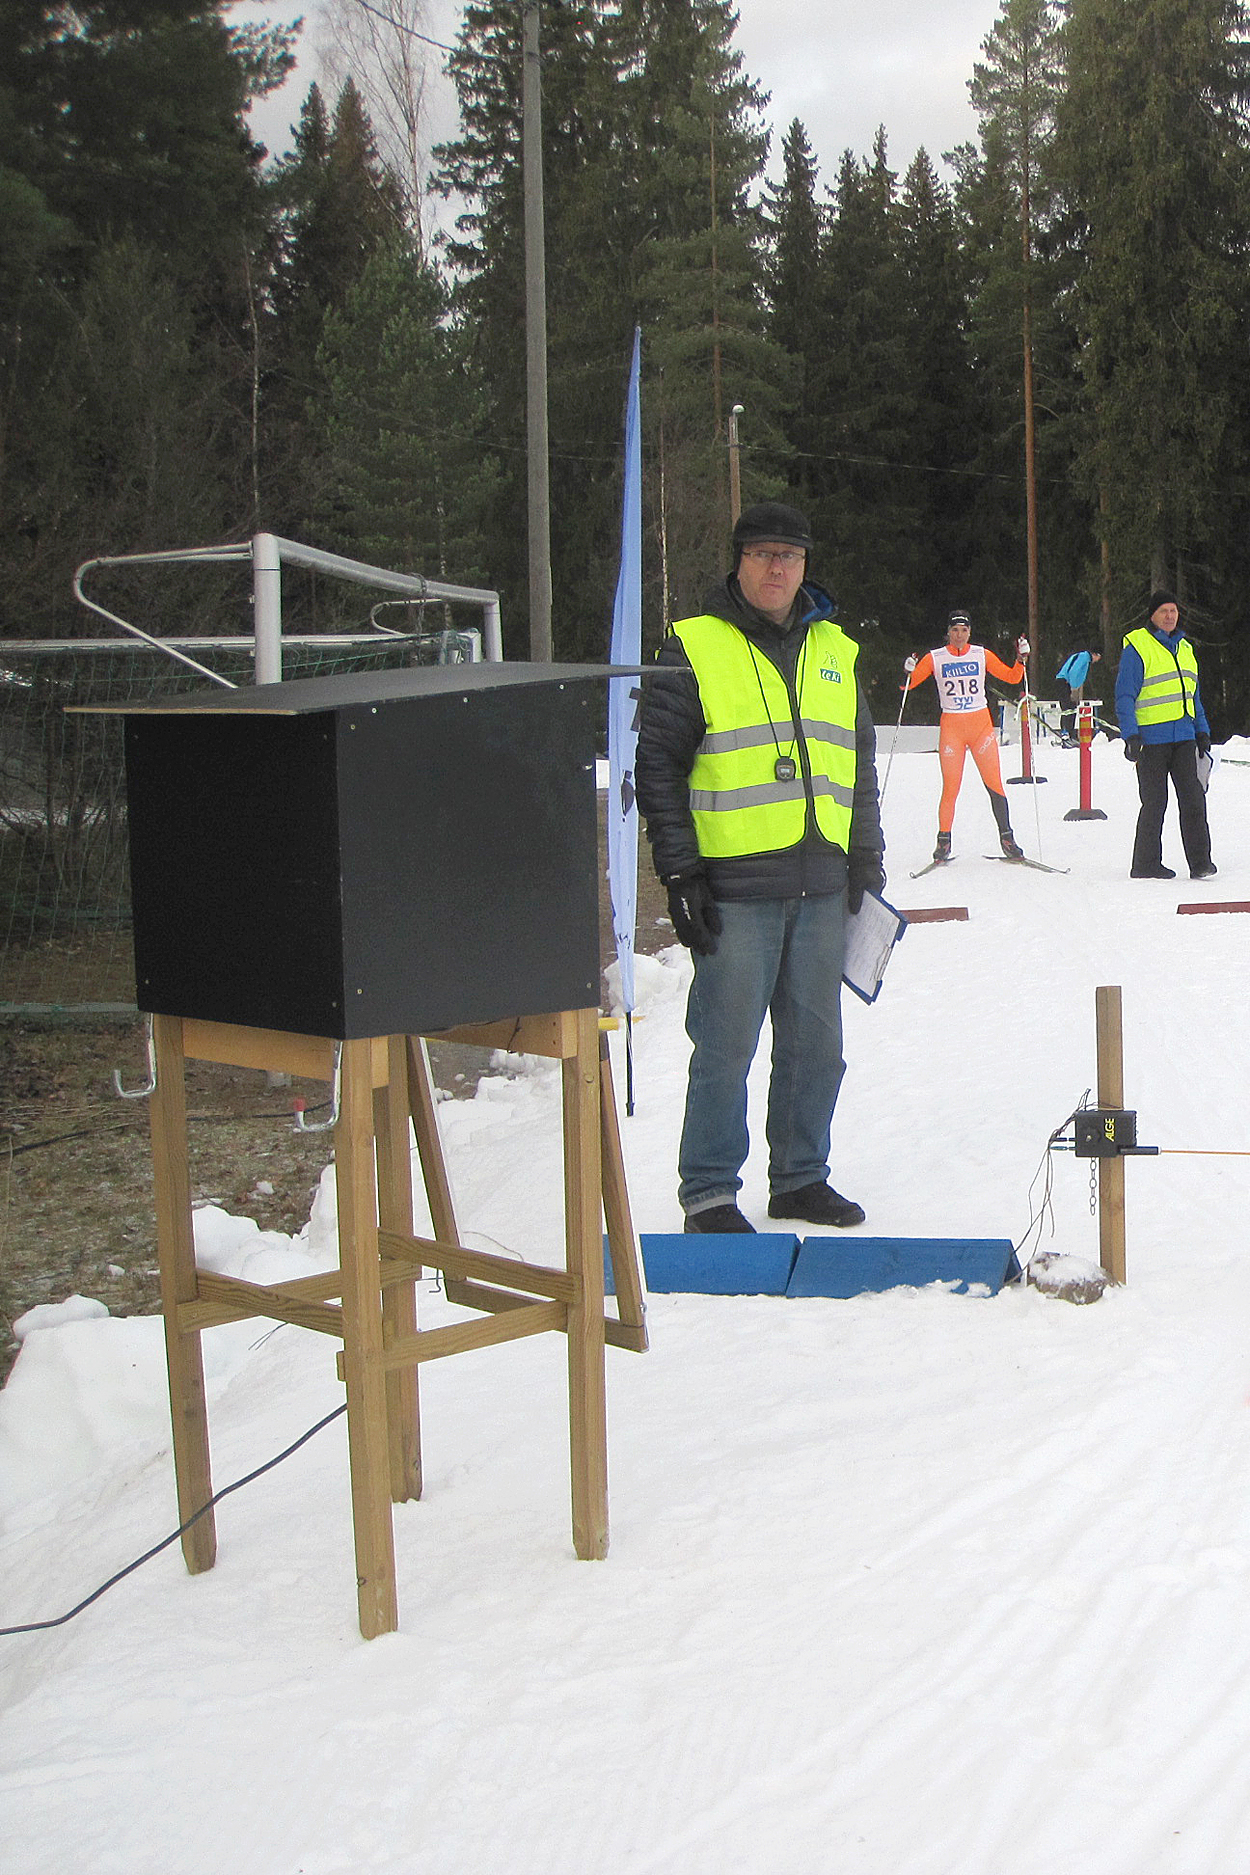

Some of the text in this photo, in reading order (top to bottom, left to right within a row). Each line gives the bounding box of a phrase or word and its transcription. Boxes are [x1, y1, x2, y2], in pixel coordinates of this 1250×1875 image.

[945, 663, 977, 678] KIILTO
[944, 679, 979, 696] 218
[1104, 1118, 1115, 1142] ALGE
